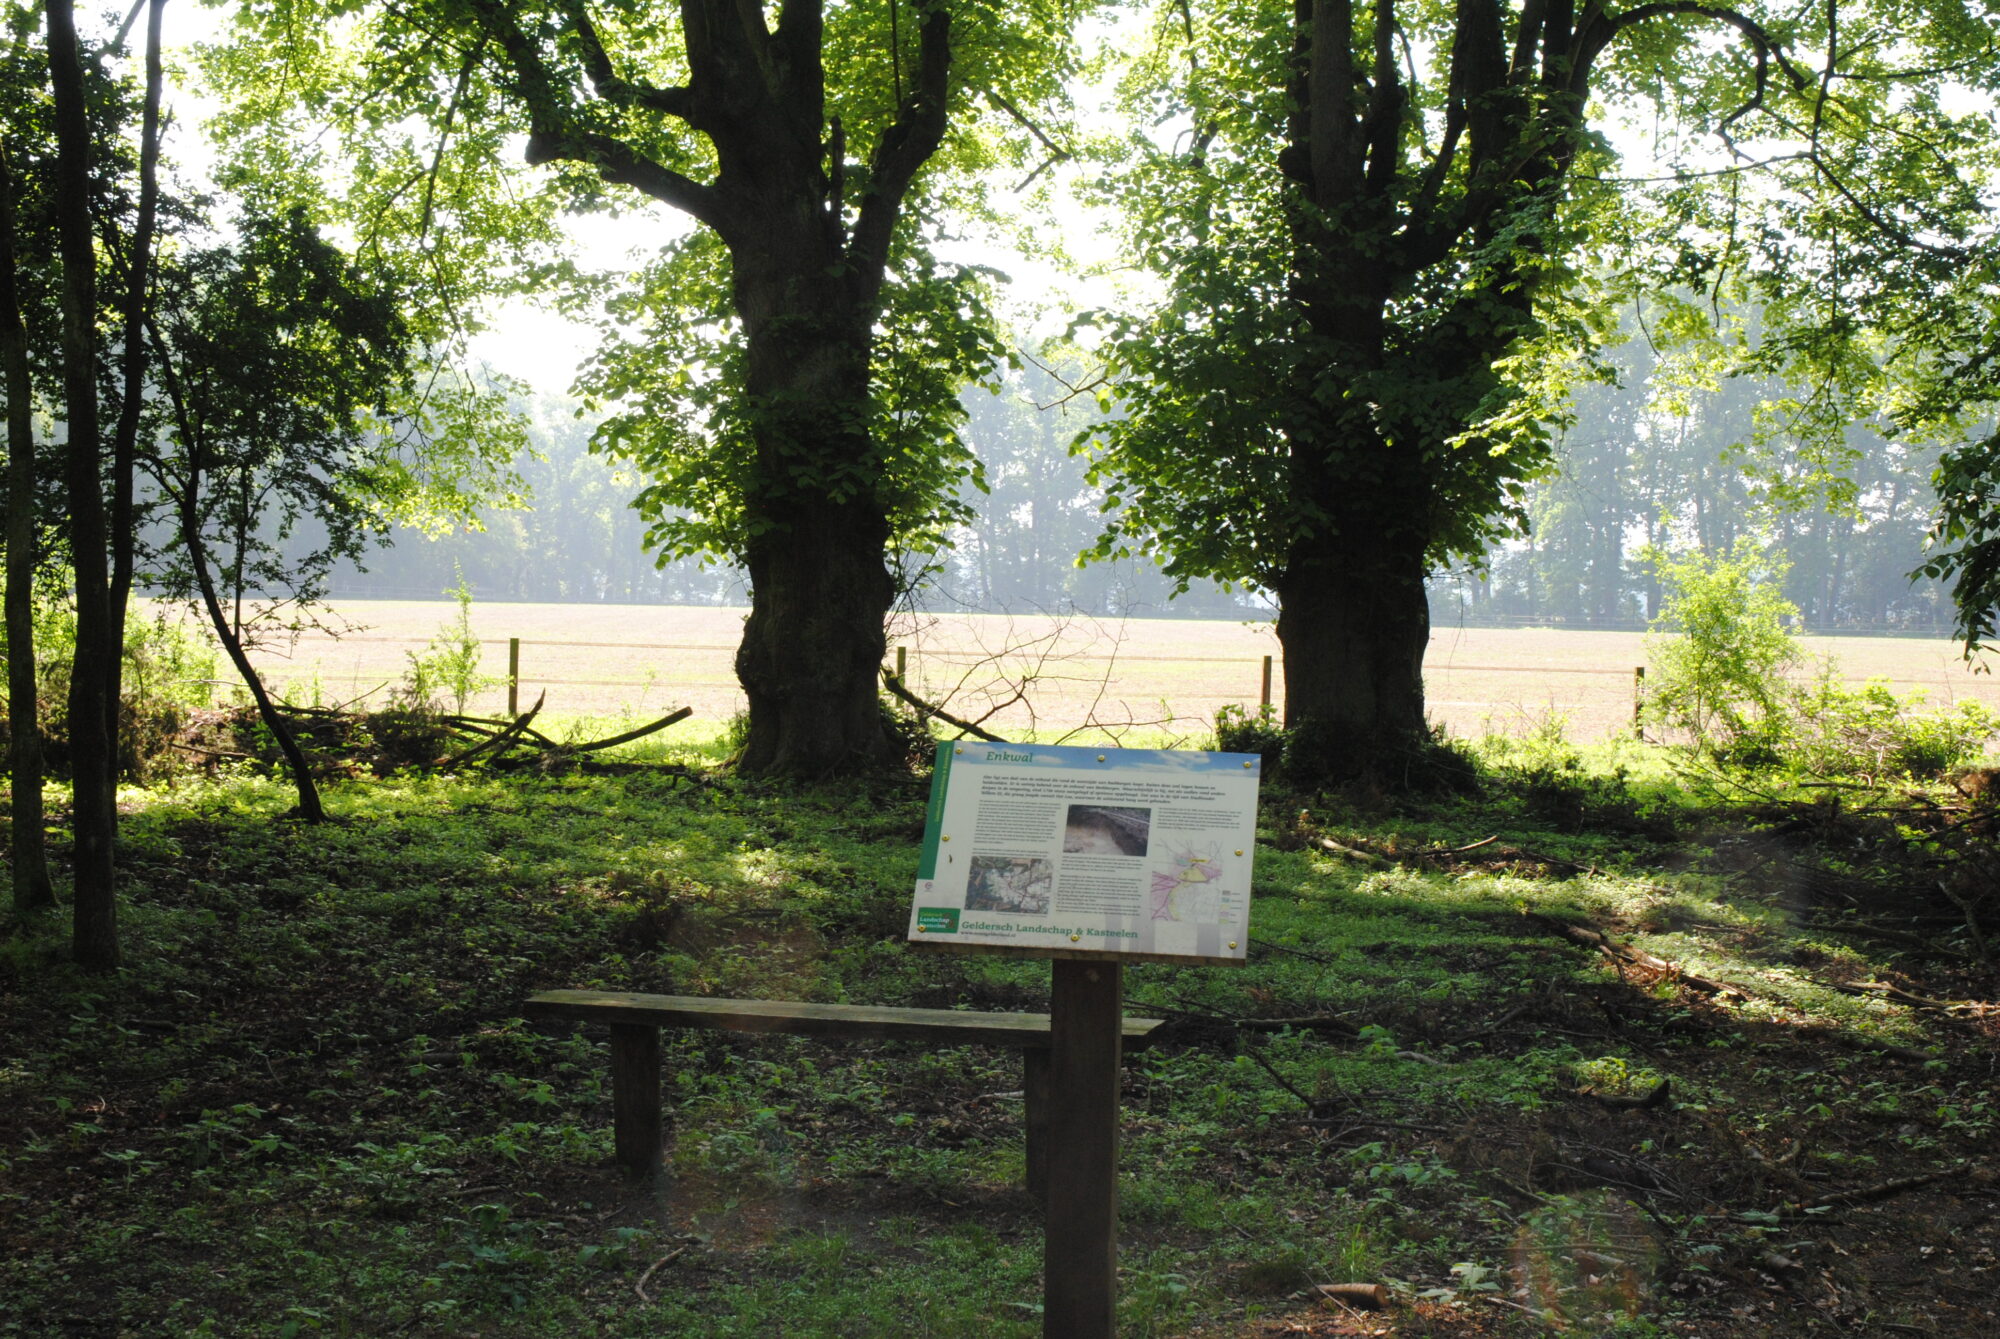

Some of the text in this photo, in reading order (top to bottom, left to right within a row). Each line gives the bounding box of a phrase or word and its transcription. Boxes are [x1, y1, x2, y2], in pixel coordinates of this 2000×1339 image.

[986, 751, 1033, 763] Enkwal
[961, 921, 1139, 939] Geldersch Landschap & Kasteelen
